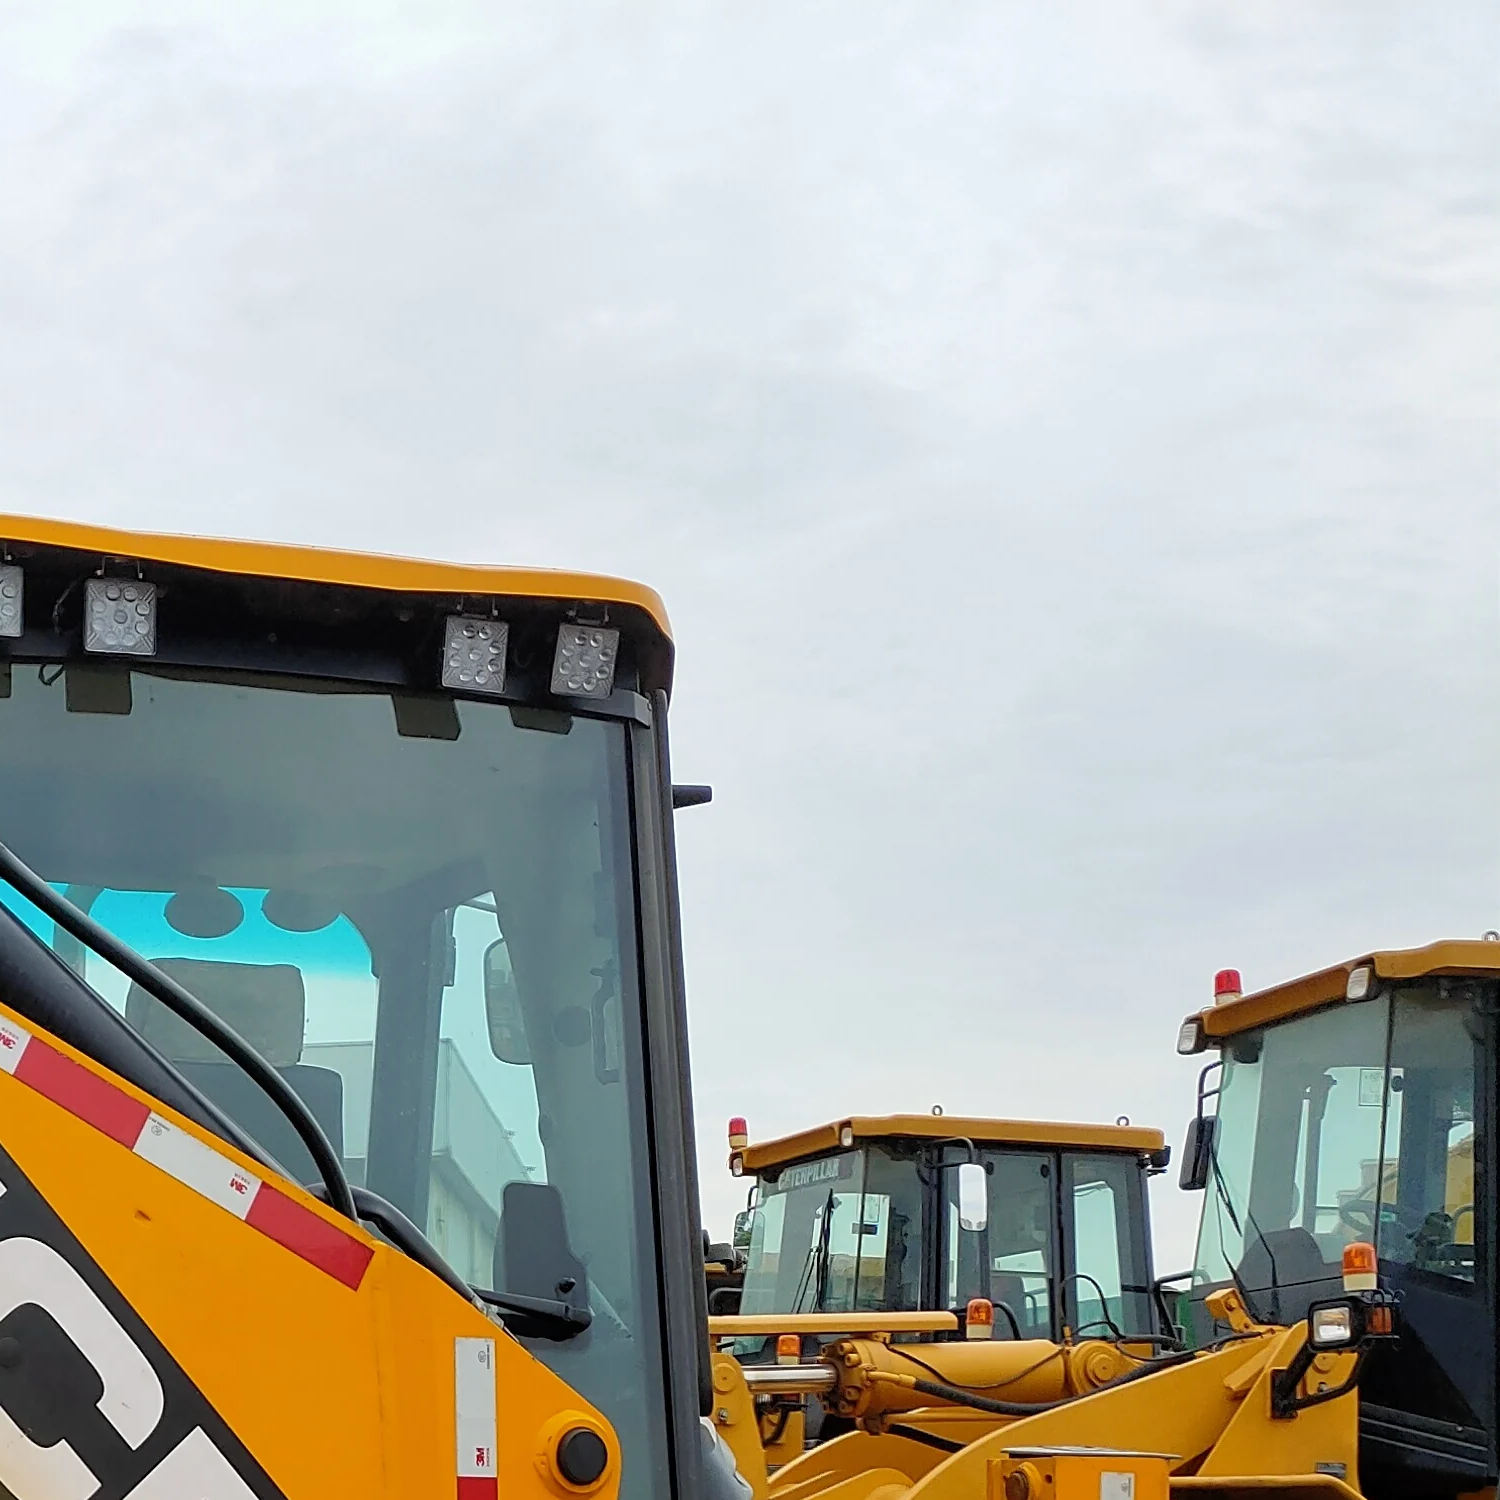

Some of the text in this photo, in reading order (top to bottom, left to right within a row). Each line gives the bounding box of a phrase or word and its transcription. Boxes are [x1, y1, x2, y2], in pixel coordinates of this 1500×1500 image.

[778, 1158, 839, 1191] CATERPILLAR
[229, 1178, 248, 1195] 3M
[475, 1447, 485, 1467] 3M
